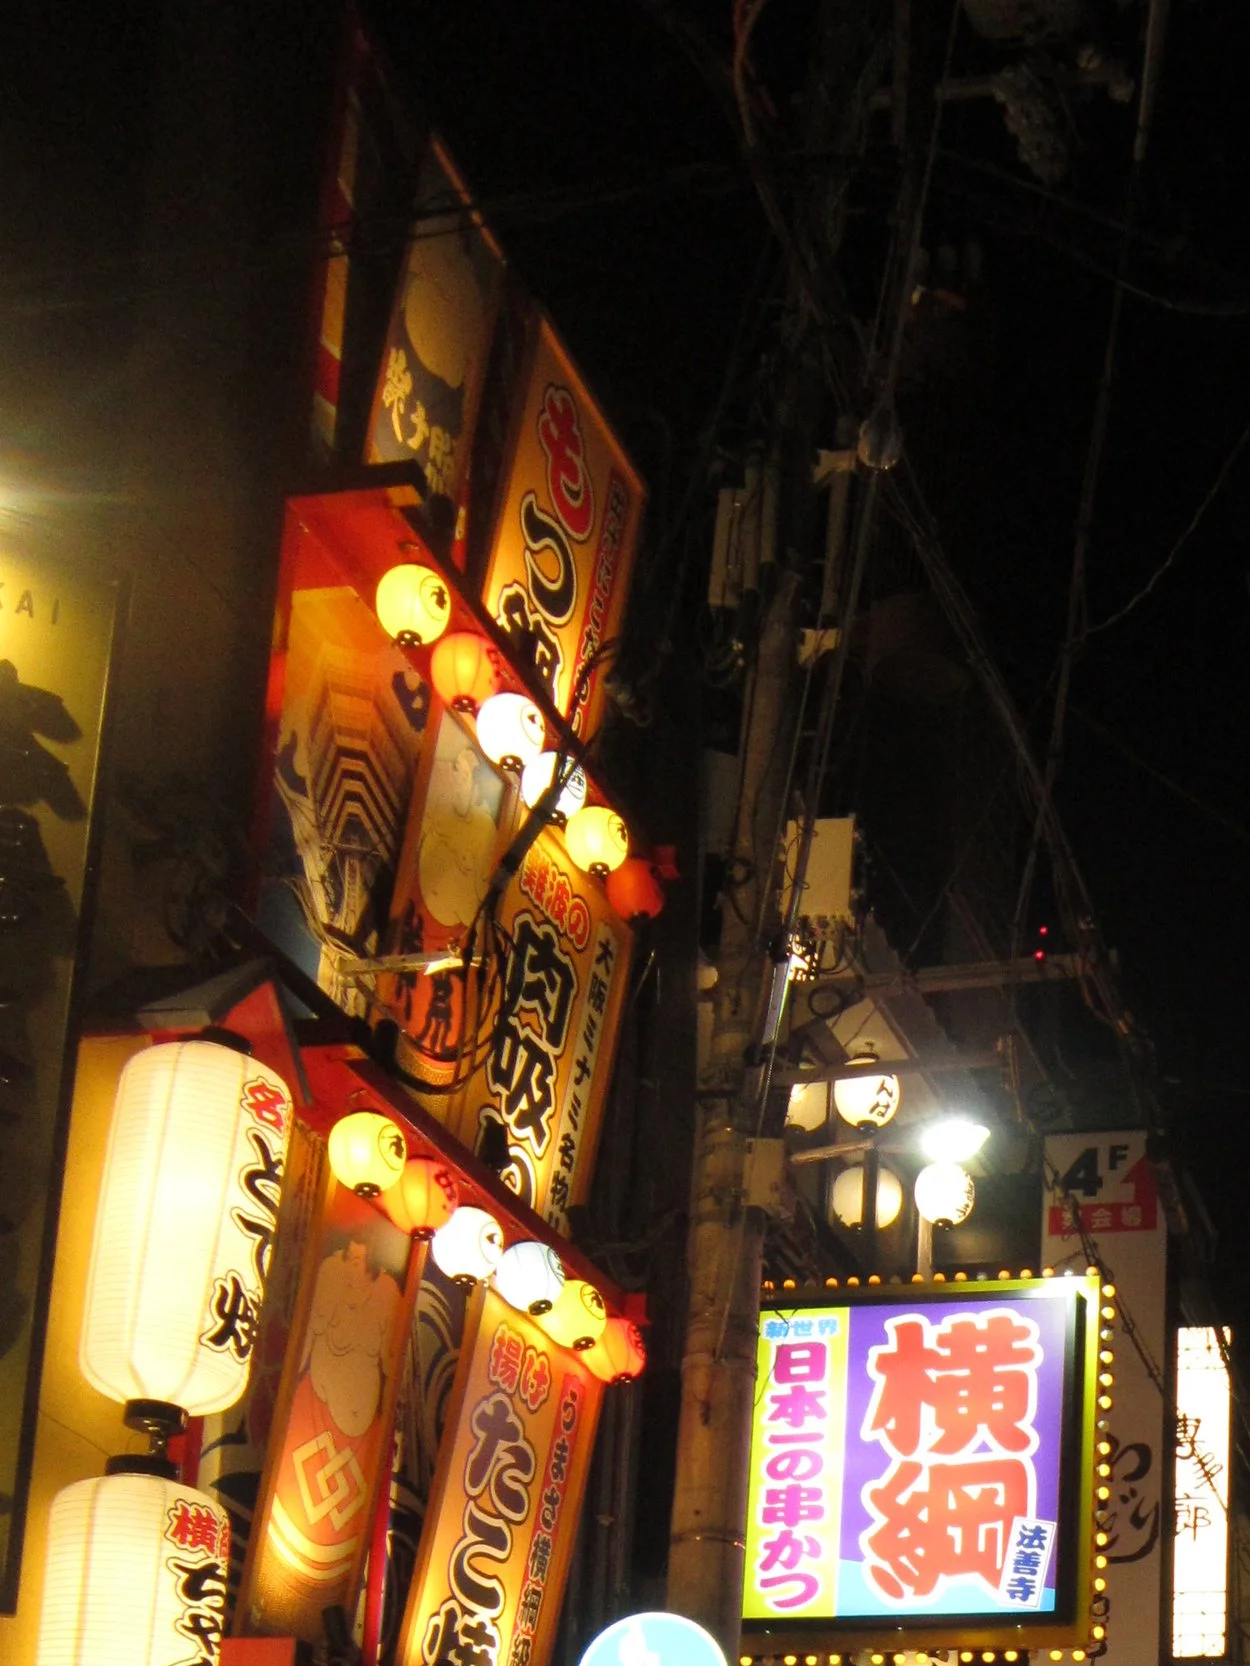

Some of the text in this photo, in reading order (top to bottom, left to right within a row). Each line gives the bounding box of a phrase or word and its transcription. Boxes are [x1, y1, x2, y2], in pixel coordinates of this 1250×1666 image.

[764, 1316, 838, 1339] 新世界
[759, 1341, 827, 1608] 日本一の串かつ
[867, 1313, 1038, 1601] 横綱
[1005, 1524, 1048, 1602] 法善寺
